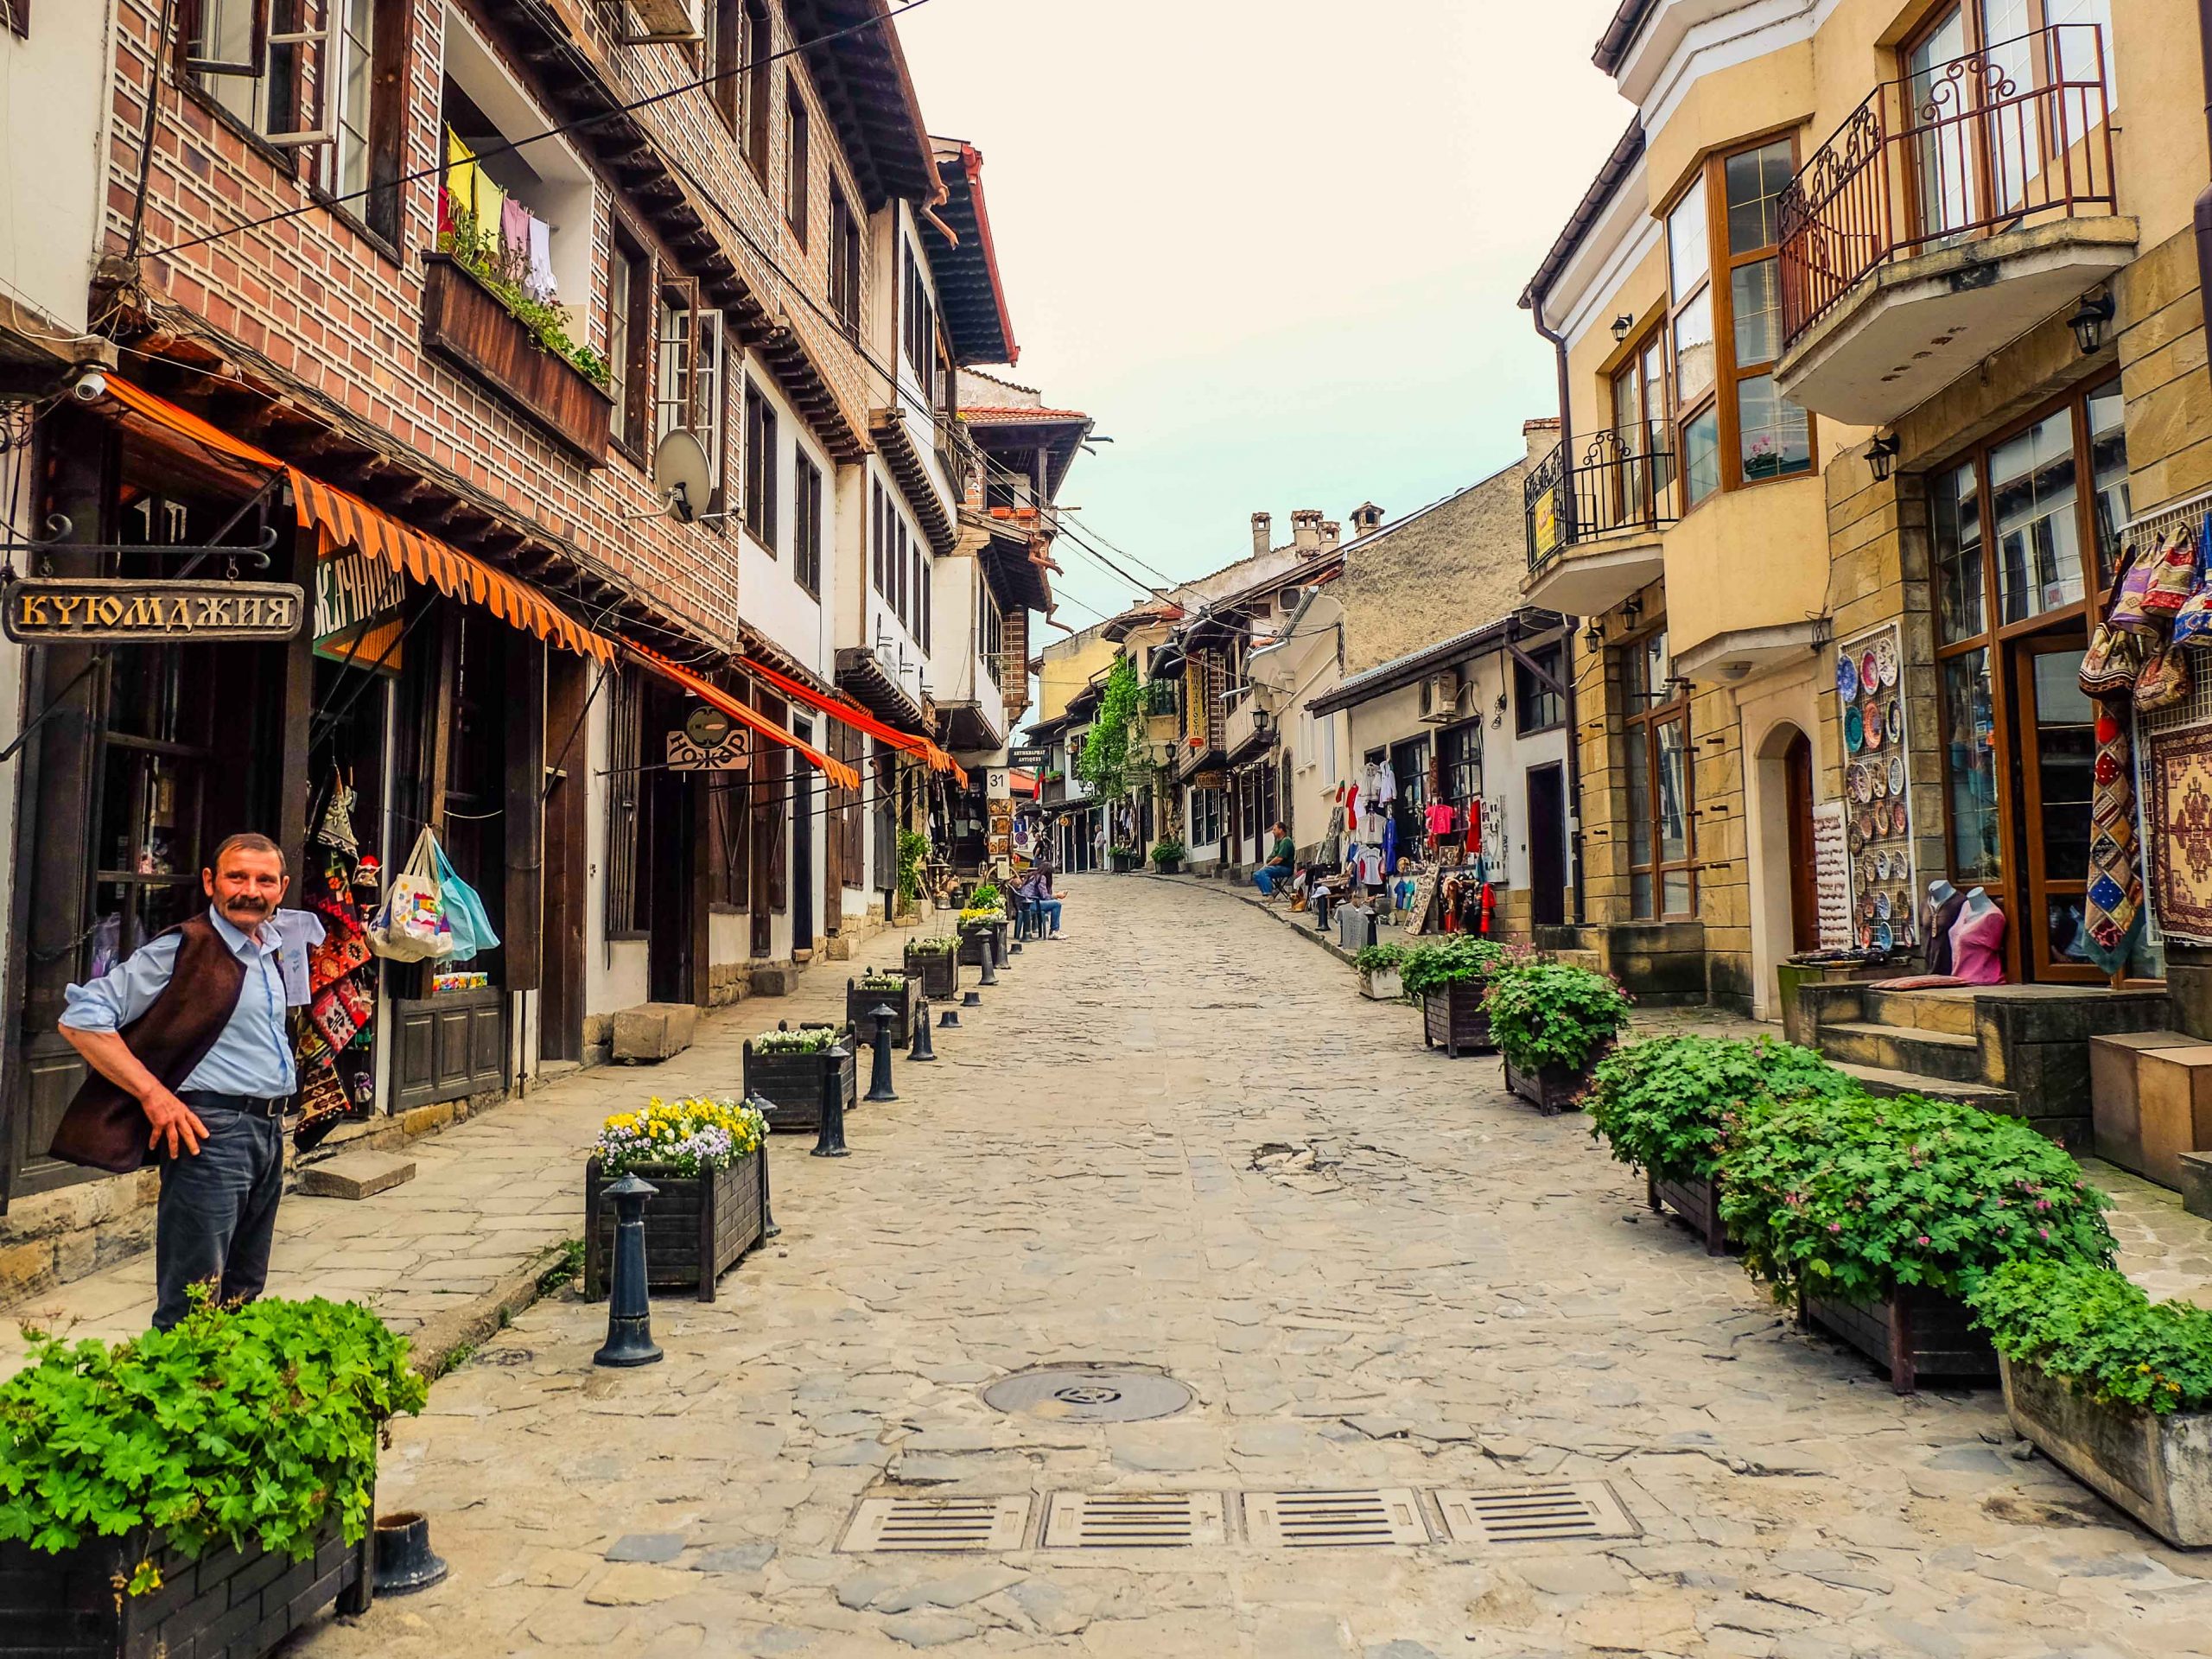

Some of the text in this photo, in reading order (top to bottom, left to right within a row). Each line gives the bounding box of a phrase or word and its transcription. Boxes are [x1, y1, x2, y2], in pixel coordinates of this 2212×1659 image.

[19, 595, 295, 633] КУЮМДЖИЯ
[669, 734, 746, 769] НОЖАР
[989, 774, 1004, 787] 31
